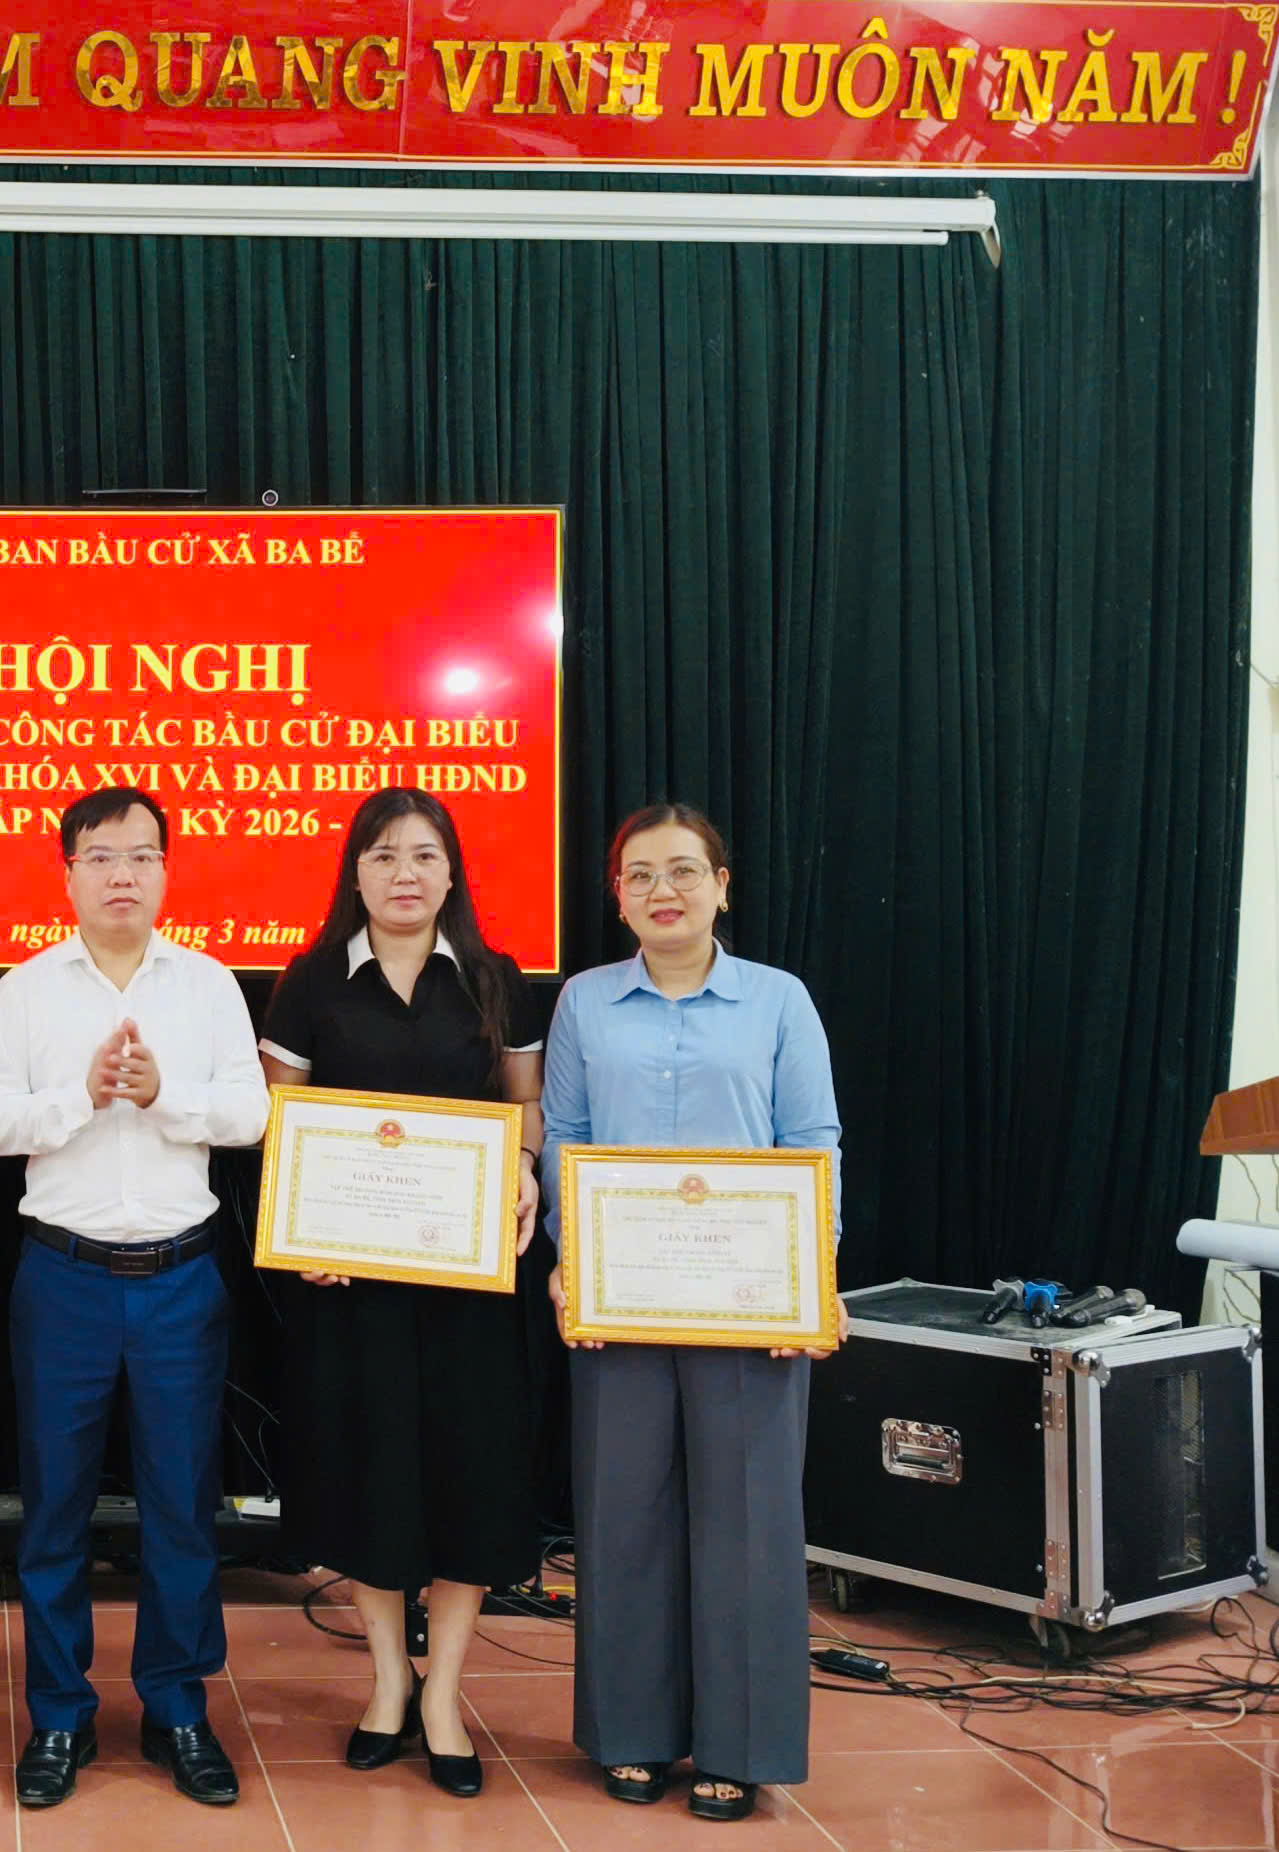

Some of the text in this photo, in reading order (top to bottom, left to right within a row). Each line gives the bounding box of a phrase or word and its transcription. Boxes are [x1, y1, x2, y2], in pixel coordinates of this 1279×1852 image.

[76, 30, 407, 111] QUANG
[433, 40, 670, 115] VINH
[689, 17, 975, 119] MUÔN
[992, 28, 1208, 124] NĂM
[69, 532, 138, 565] BẦU
[148, 532, 201, 565] CỬ
[208, 533, 257, 565] XÃ
[266, 538, 313, 565] BA
[320, 531, 365, 565] BỂ
[131, 643, 311, 706] NGHỊ
[104, 711, 182, 747] TÁC
[192, 711, 271, 748] BẦU
[280, 711, 340, 748] CỬ
[347, 719, 417, 755] ĐẠI
[426, 711, 519, 748] BIỂU
[93, 763, 161, 791] XVI
[170, 756, 224, 792] VÀ
[234, 763, 302, 799] ĐẠI
[312, 757, 404, 792] BIỂU
[416, 764, 527, 792] HĐND
[179, 800, 234, 836] KỲ
[244, 807, 320, 836] 2026
[217, 918, 235, 945] 3
[242, 918, 305, 945] năm
